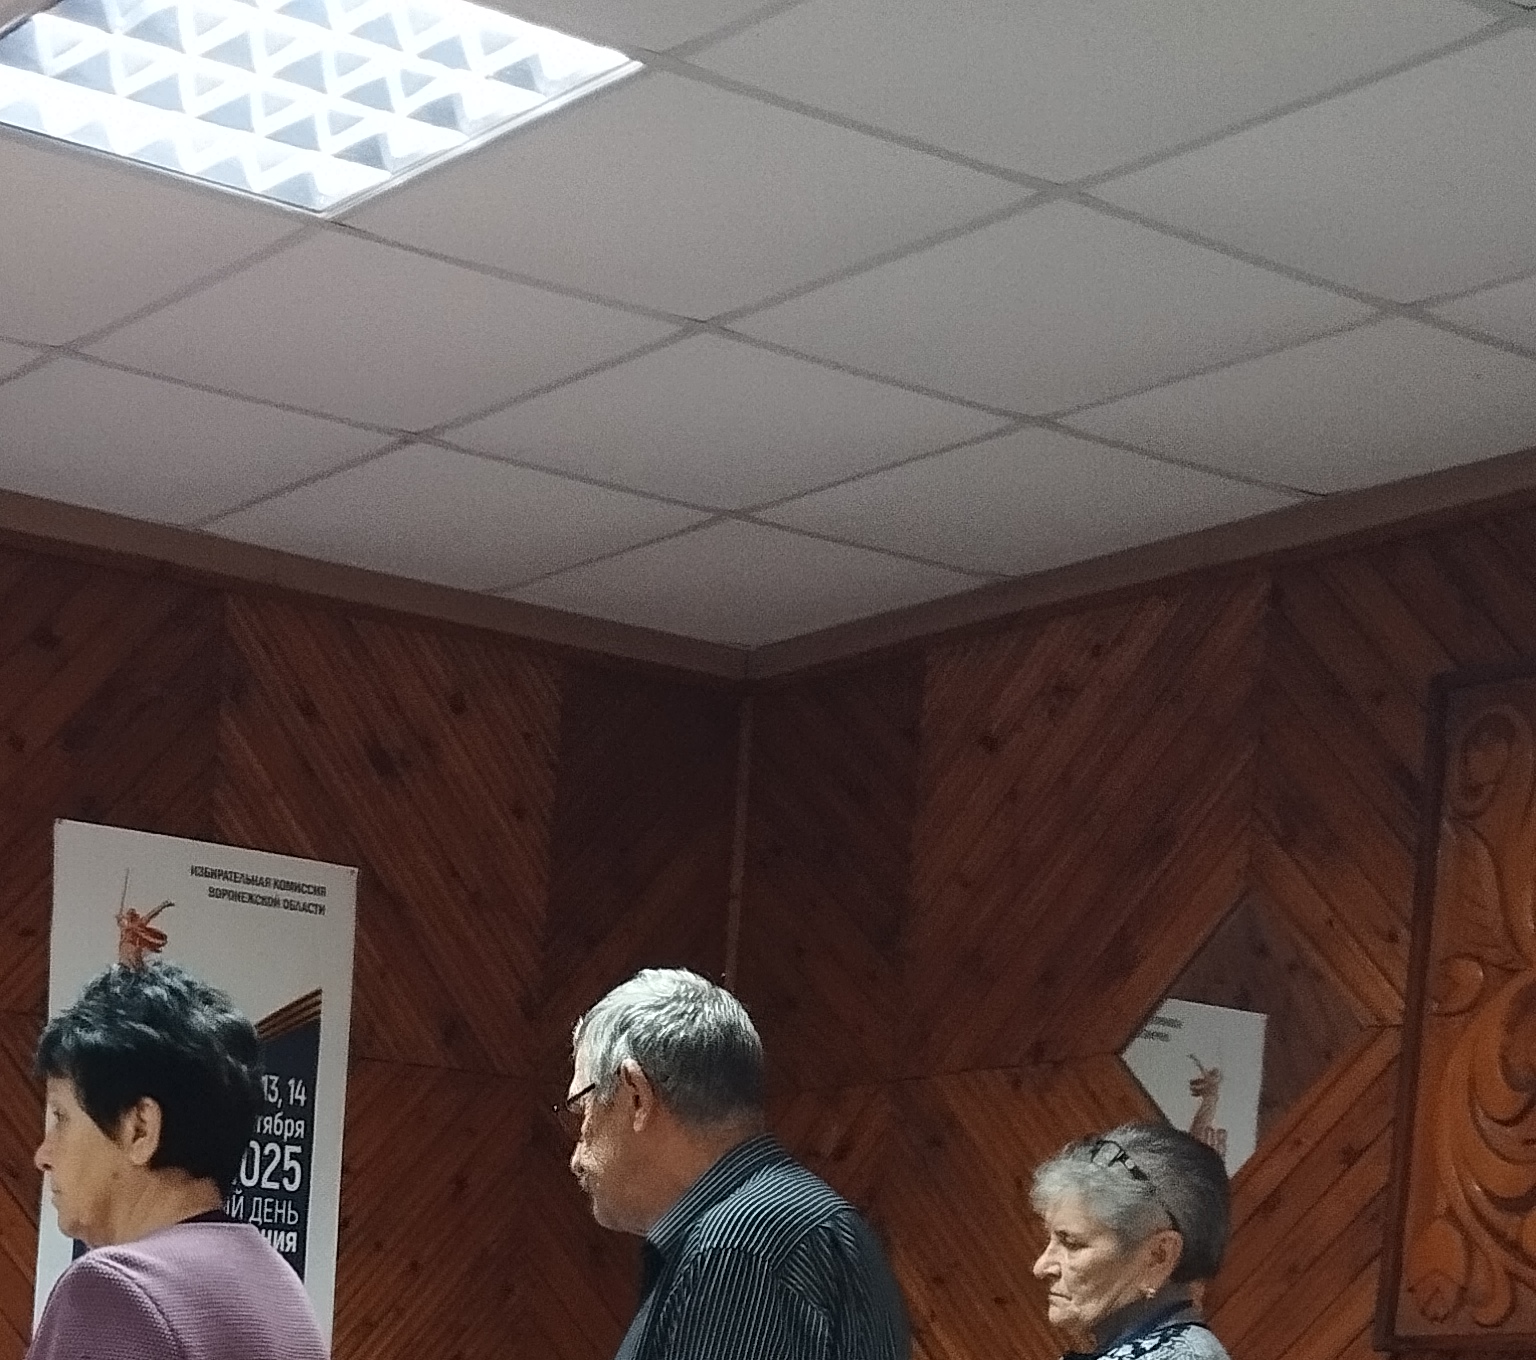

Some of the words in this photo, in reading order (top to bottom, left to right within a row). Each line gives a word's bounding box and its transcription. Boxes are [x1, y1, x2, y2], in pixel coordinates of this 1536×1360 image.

[190, 865, 272, 888] ИЗБИРАТЕЛЬНАЯ
[273, 877, 327, 897] КОМИССИЯ
[208, 886, 280, 908] ВОРОНЕЖСКОЙ
[283, 898, 326, 915] ОБЛАСТИ
[288, 1078, 307, 1107] 14
[255, 1112, 305, 1142] тября
[238, 1140, 302, 1192] 025
[249, 1197, 299, 1225] ДЕНЬ
